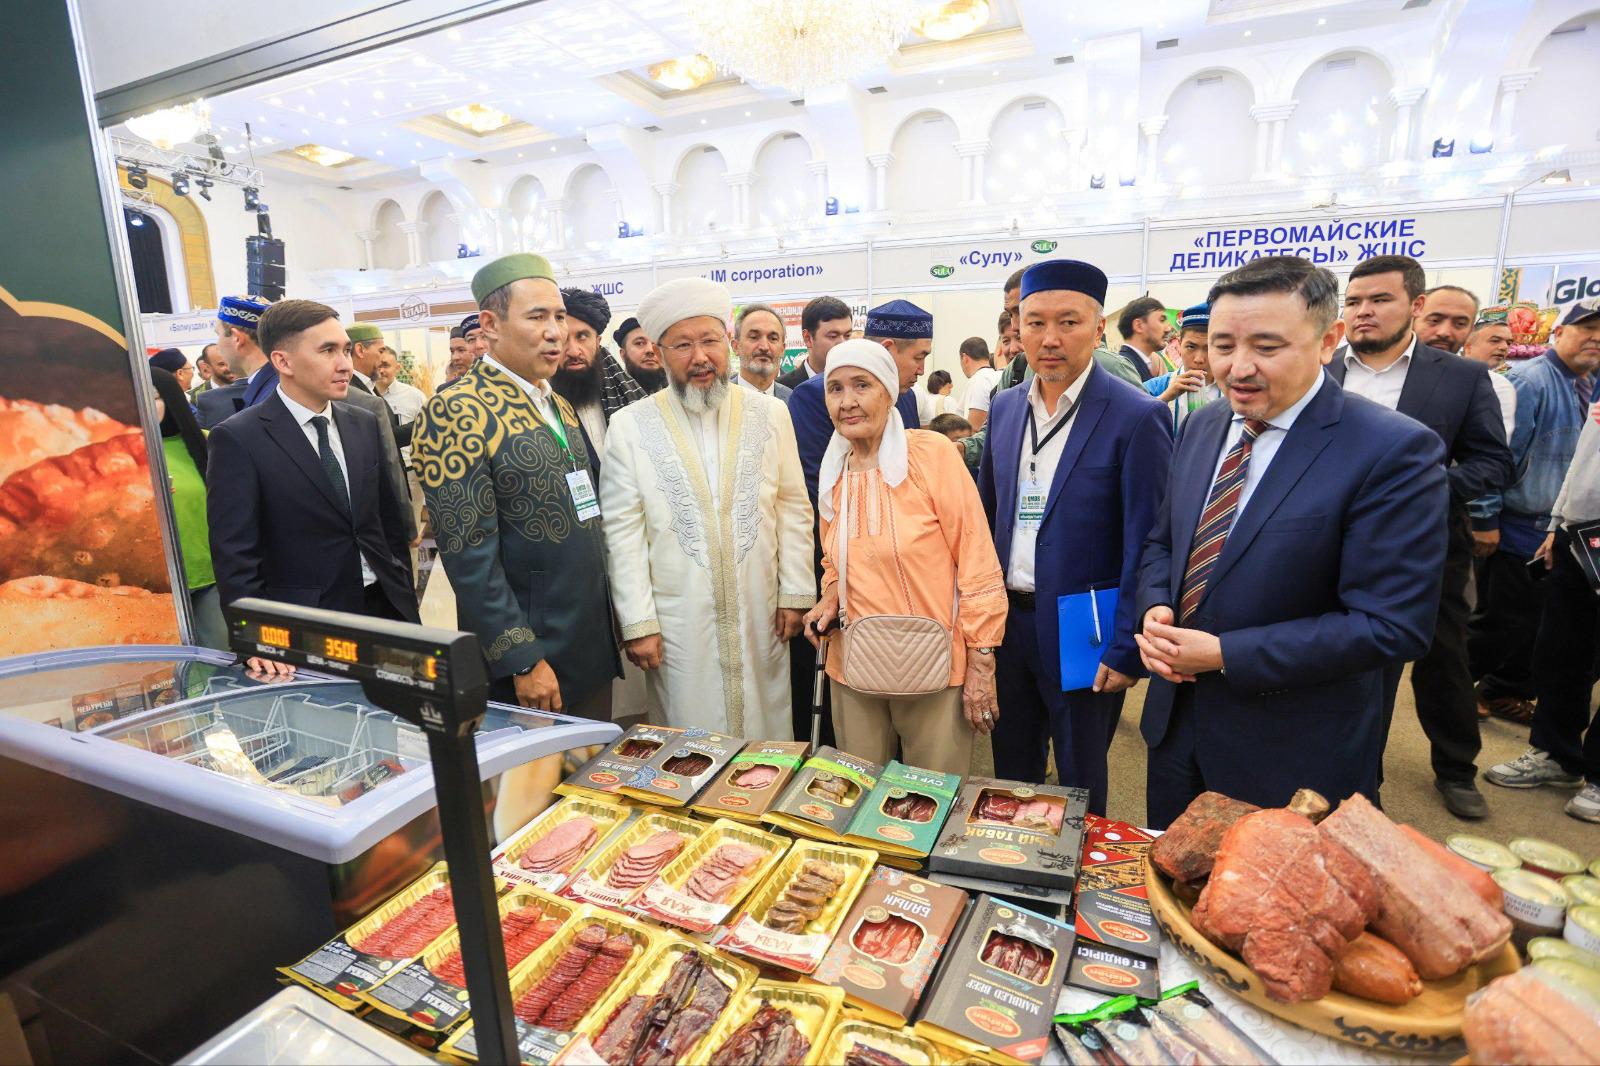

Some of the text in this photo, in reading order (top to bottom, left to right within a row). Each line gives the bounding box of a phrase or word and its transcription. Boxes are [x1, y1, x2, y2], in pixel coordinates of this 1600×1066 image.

[1193, 218, 1416, 248] «ПЕРВОМАЙСКИЕ
[959, 250, 1023, 268] «Сулу»
[730, 263, 824, 284] corporation»
[590, 280, 624, 296] ЖШС
[659, 895, 693, 916] ЖАЯ
[1132, 960, 1147, 970] ЕТ
[966, 979, 991, 998] BEEF
[994, 990, 1041, 1016] MARBLED
